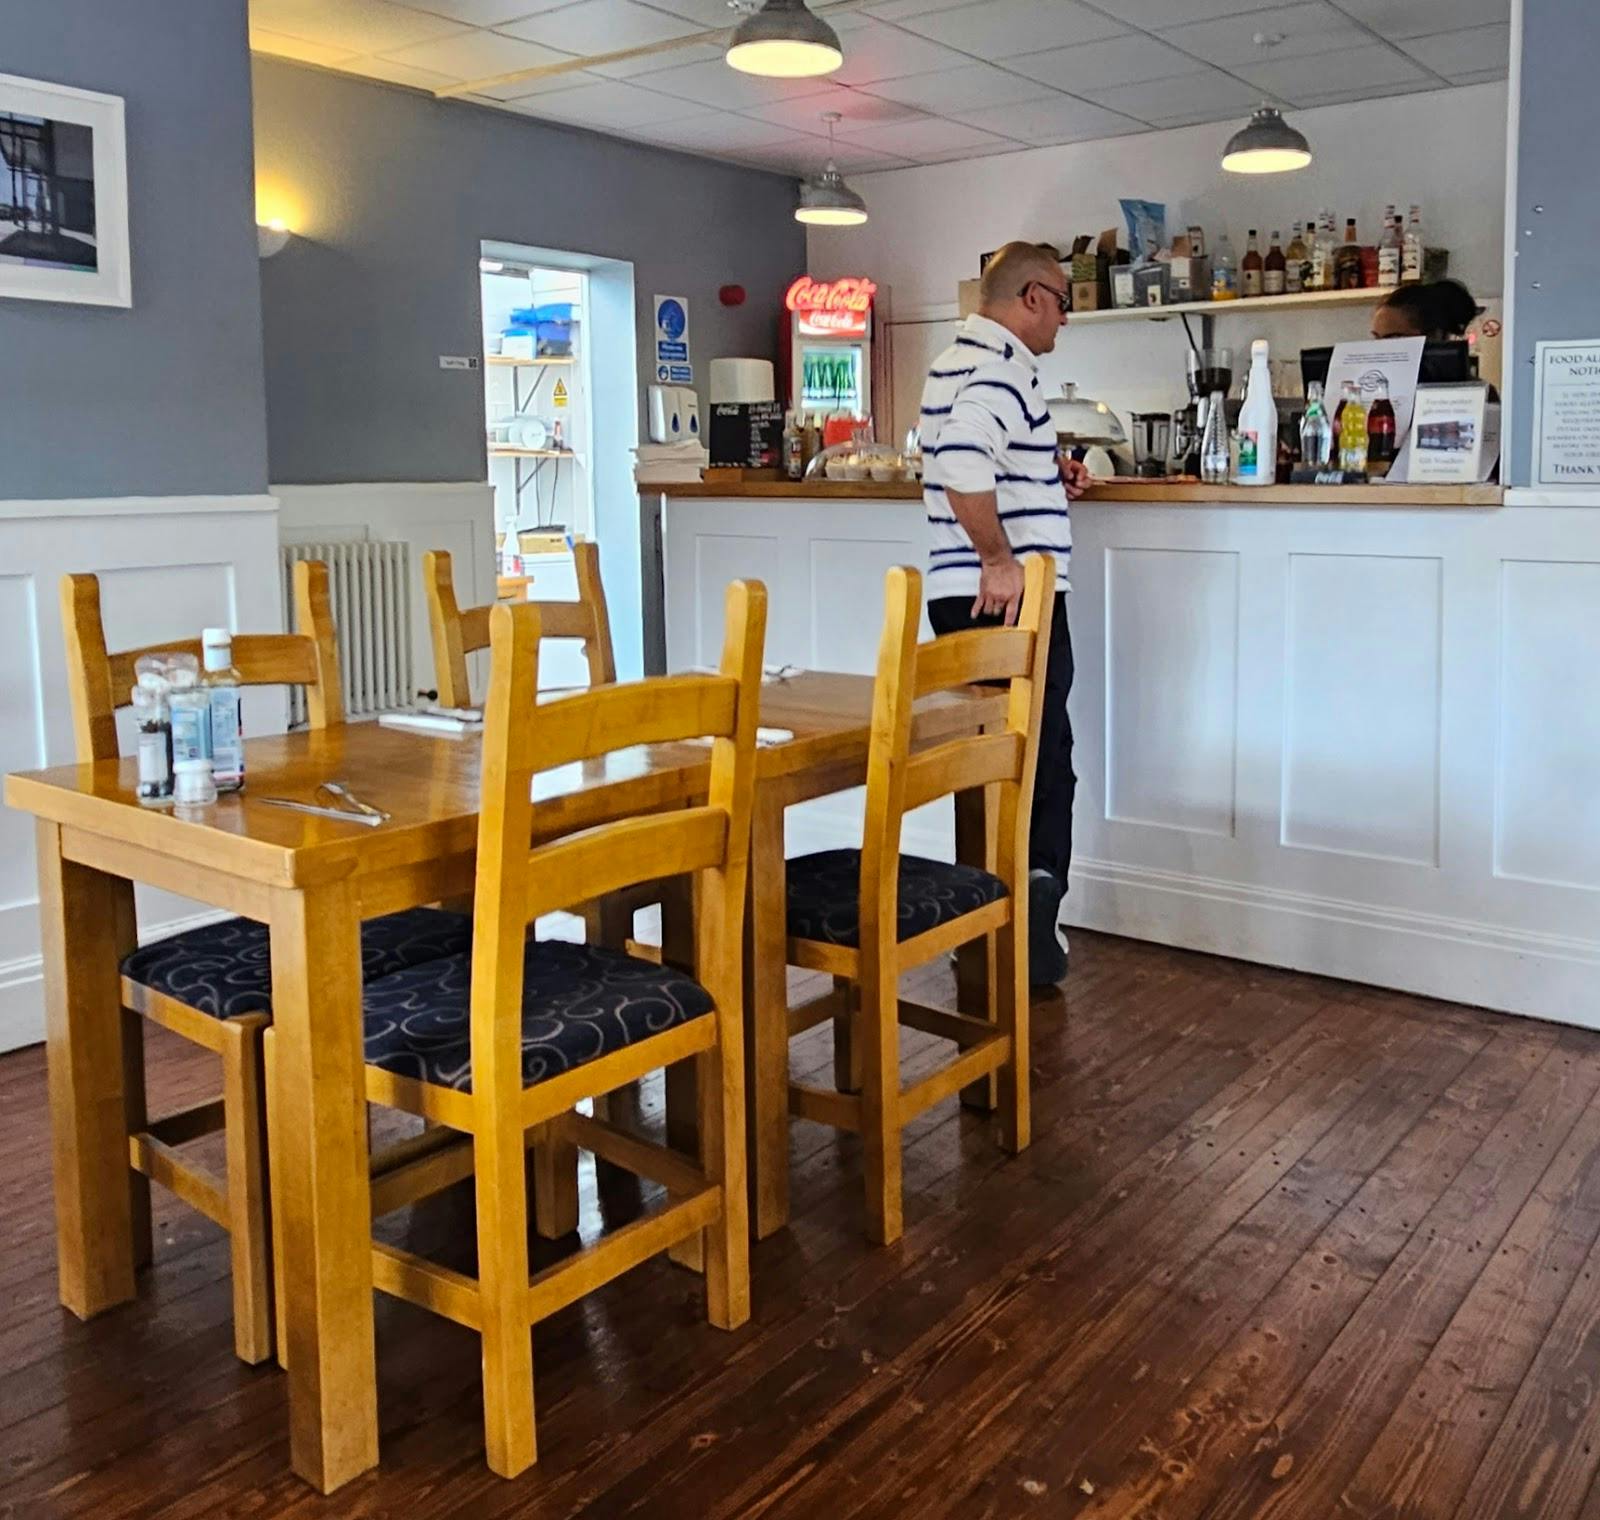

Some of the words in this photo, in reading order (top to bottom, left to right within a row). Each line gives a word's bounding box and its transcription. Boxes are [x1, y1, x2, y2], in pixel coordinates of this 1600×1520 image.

[1550, 355, 1583, 364] FOOD
[1585, 354, 1600, 364] AL
[1569, 366, 1600, 377] NOTI
[1552, 463, 1595, 474] THANK
